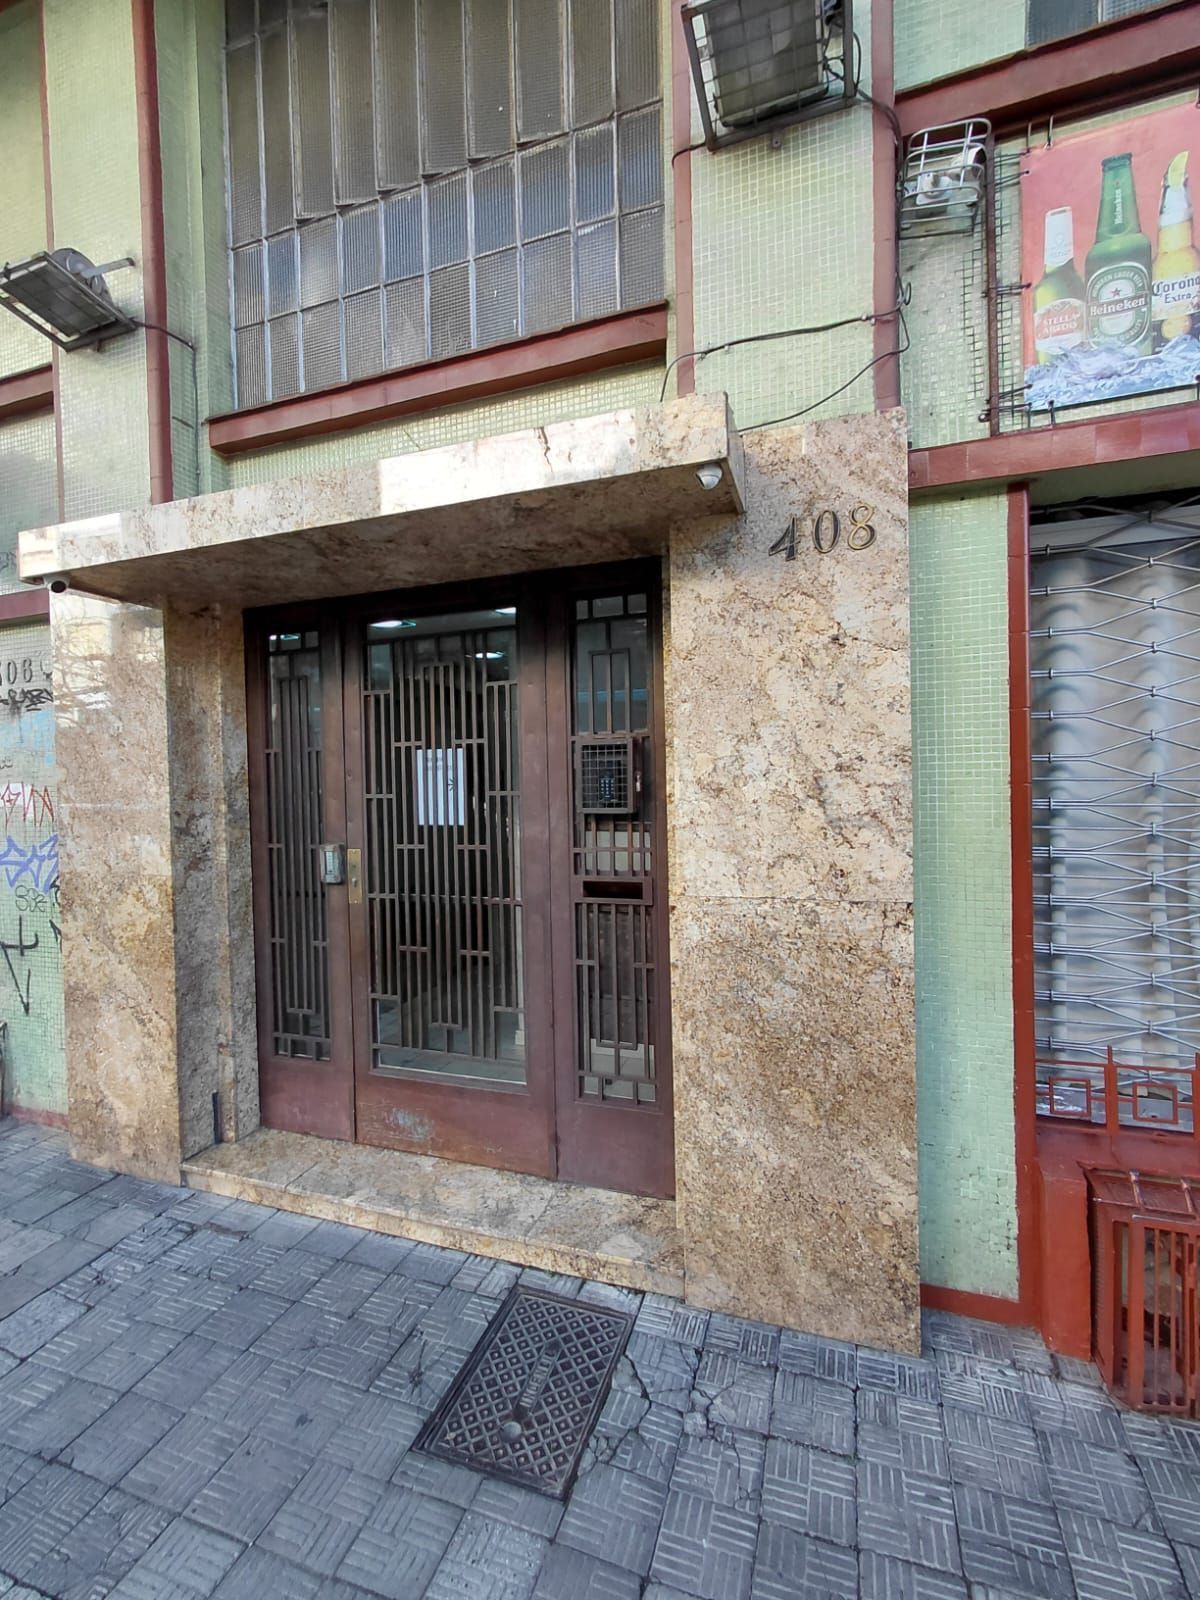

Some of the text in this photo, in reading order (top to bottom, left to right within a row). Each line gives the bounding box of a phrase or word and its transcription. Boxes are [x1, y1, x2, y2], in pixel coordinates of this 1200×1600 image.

[1113, 188, 1122, 225] Heineken
[1090, 297, 1146, 316] Heineken
[1164, 294, 1192, 304] Extra
[1042, 311, 1081, 325] STELLA
[769, 502, 877, 562] 408
[0, 656, 33, 686] 08
